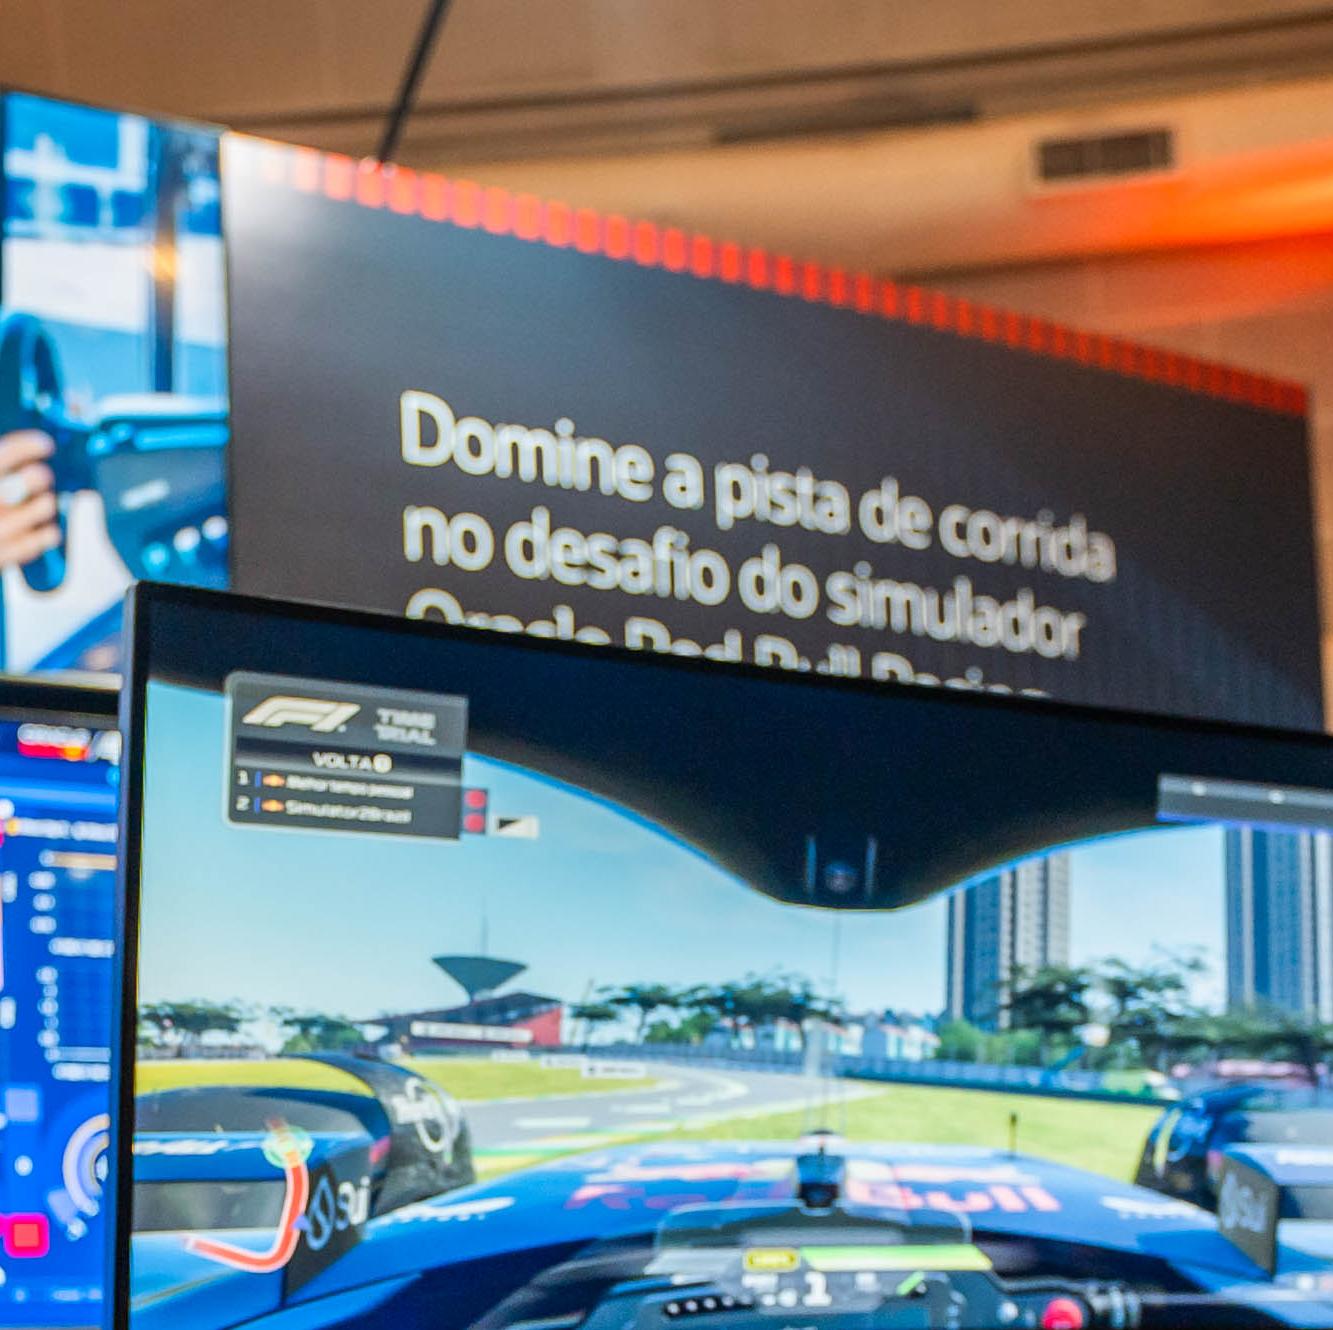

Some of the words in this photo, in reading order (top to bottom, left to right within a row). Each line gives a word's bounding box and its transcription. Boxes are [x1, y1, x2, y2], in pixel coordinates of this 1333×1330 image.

[400, 390, 655, 501] Domine
[662, 453, 704, 510] a
[715, 453, 851, 531] pista
[858, 476, 933, 550] de
[939, 508, 1117, 583] corrida
[403, 505, 495, 571] no
[505, 505, 731, 606] desafio
[738, 543, 818, 619] do
[825, 561, 1088, 660] simulador
[312, 751, 372, 769] VOLTA
